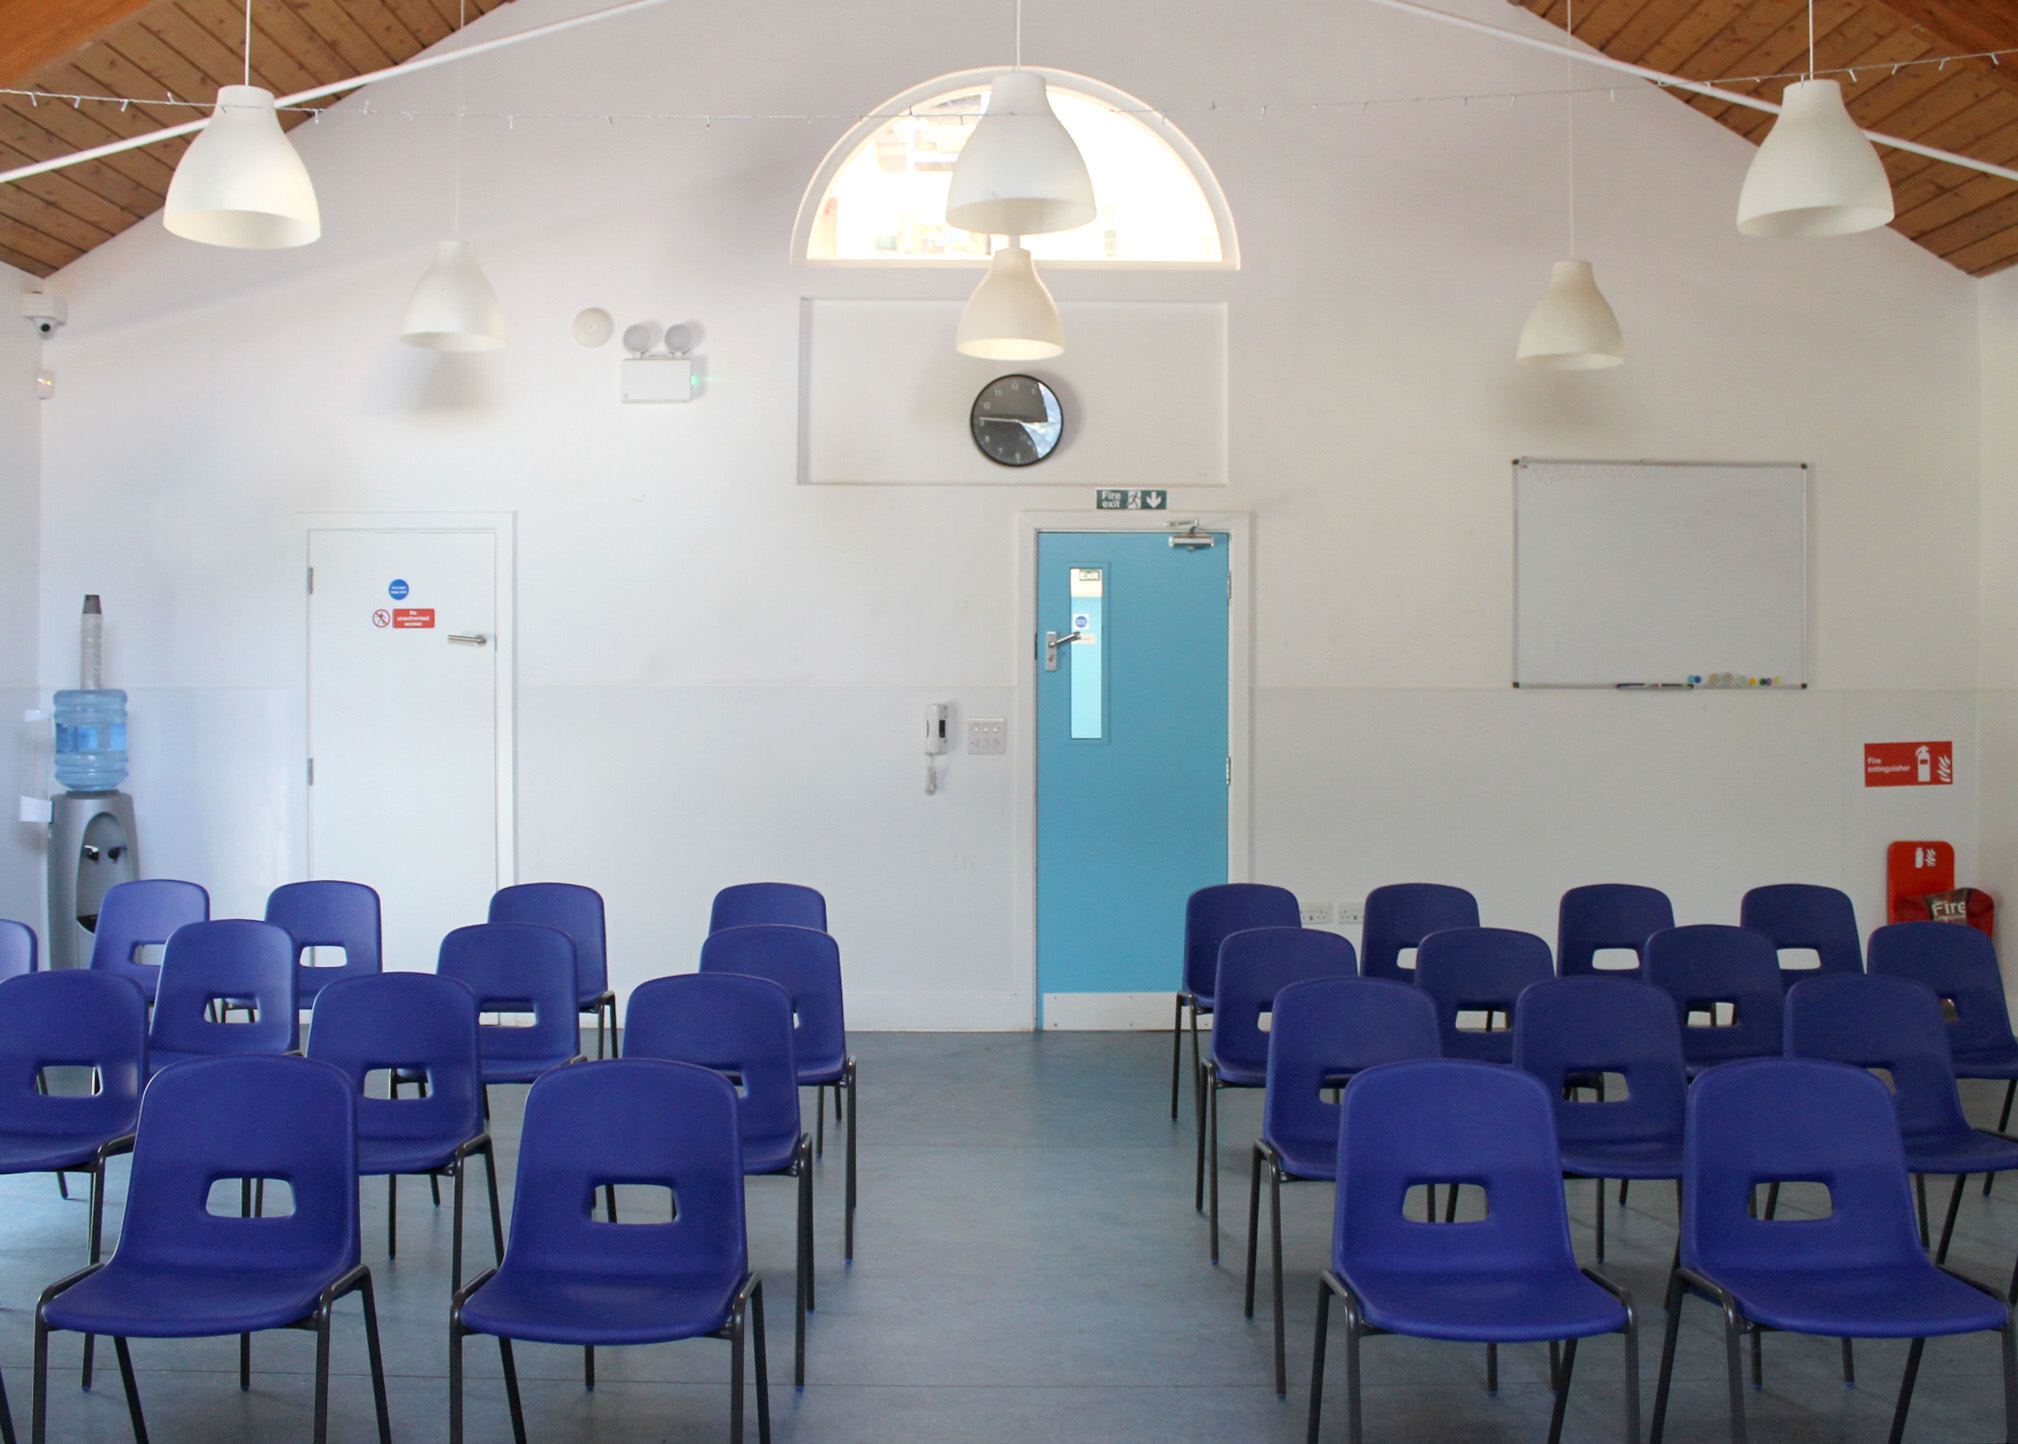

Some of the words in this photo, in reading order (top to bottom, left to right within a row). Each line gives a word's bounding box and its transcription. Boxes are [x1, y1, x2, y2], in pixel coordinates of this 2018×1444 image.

[1011, 383, 1019, 391] 12
[994, 389, 1002, 397] 11
[983, 401, 991, 410] 10
[1101, 490, 1121, 500] Fire
[1101, 500, 1120, 508] exit
[1931, 901, 1966, 916] Fire
